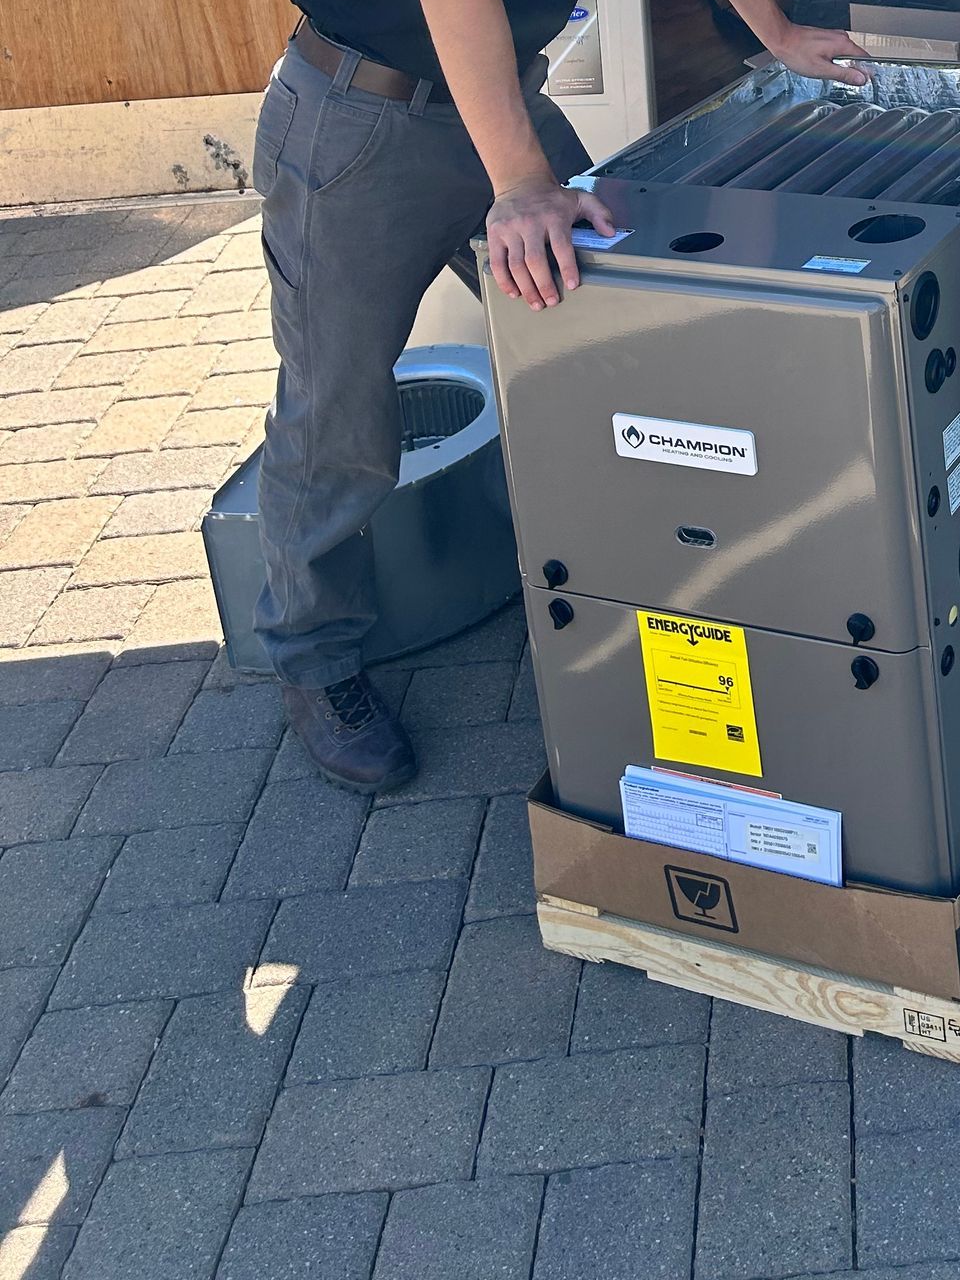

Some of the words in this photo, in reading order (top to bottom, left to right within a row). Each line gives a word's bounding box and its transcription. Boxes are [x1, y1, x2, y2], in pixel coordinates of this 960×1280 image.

[649, 434, 746, 458] CHAMPION
[662, 448, 689, 457] HEATING
[704, 454, 733, 463] COOLING
[718, 675, 734, 687] 96
